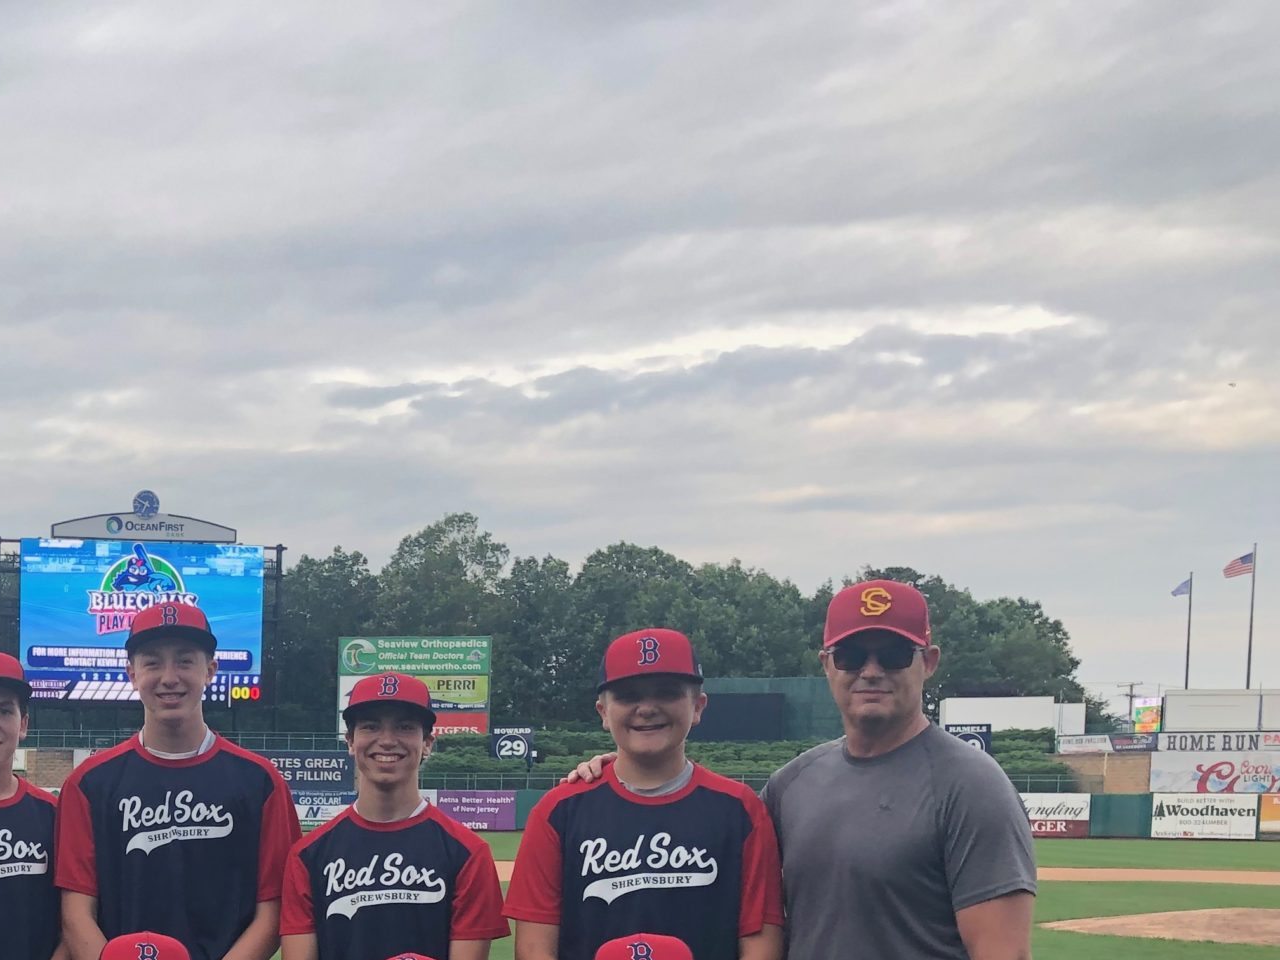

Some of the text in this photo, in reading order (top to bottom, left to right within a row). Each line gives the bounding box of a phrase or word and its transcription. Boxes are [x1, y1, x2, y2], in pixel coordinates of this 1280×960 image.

[100, 614, 125, 631] PLAY
[159, 605, 178, 627] B
[377, 639, 488, 651] Seaview Orthopaedics
[637, 636, 661, 666] B
[32, 647, 46, 657] FOR
[47, 647, 67, 657] MORE
[68, 648, 116, 658] INFORMATION
[213, 650, 248, 661] PERIENCE
[378, 652, 464, 660] Official Team Doctors
[64, 657, 96, 667] CONTACT
[96, 658, 118, 667] KEVIN
[377, 662, 481, 671] www.seaviewortho.com
[378, 674, 399, 698] B
[437, 679, 476, 691] PERRI
[499, 740, 526, 756] 29
[1166, 735, 1216, 751] HOME
[1221, 735, 1260, 751] RUN
[271, 757, 348, 770] STES GREAT,
[296, 771, 342, 781] FILLING
[299, 796, 341, 805] GO SOLAR!
[119, 790, 224, 833] Red Sox
[477, 806, 499, 814] Jersey
[1166, 804, 1256, 817] Woodhaven
[1031, 821, 1067, 832] AGER
[579, 832, 709, 877] Red Sox
[324, 853, 434, 896] Red Sox
[611, 876, 692, 891] SHREWSBURY
